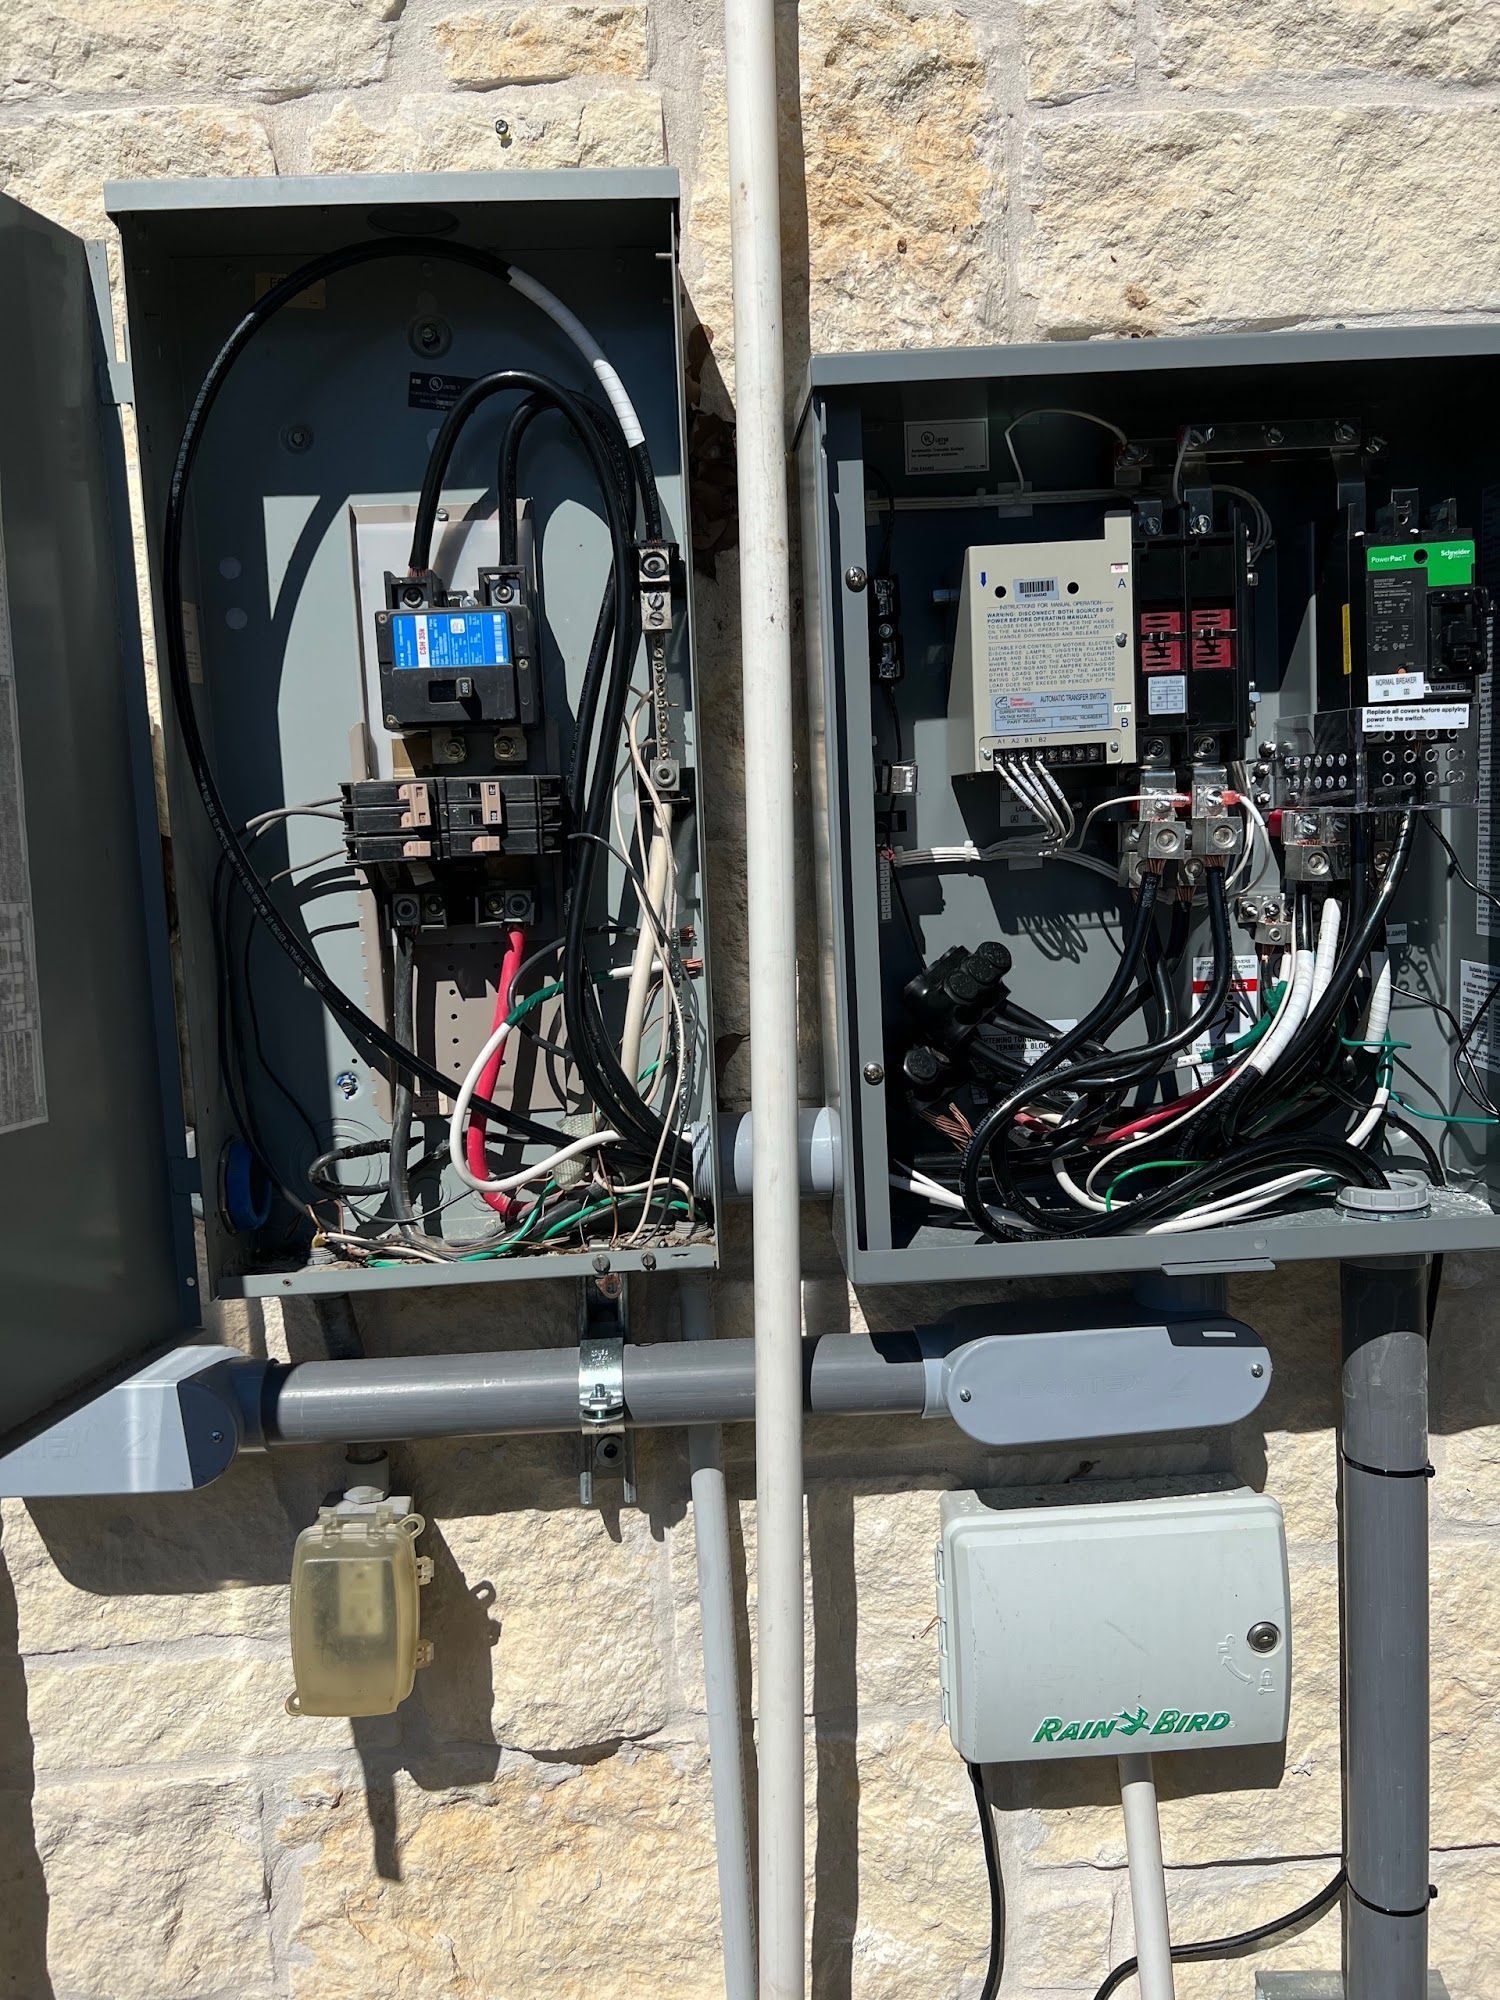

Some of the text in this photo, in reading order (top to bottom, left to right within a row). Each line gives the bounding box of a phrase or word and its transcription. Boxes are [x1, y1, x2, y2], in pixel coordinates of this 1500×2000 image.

[1371, 554, 1407, 563] PowerPacT
[1441, 549, 1471, 560] Schneider
[1118, 578, 1126, 588] A
[419, 642, 427, 655] CSH
[1376, 678, 1395, 686] NORMAL
[1040, 694, 1065, 702] AUTOMATIC
[1121, 718, 1129, 728] B
[1032, 1708, 1231, 1742] RAIN BIRD
